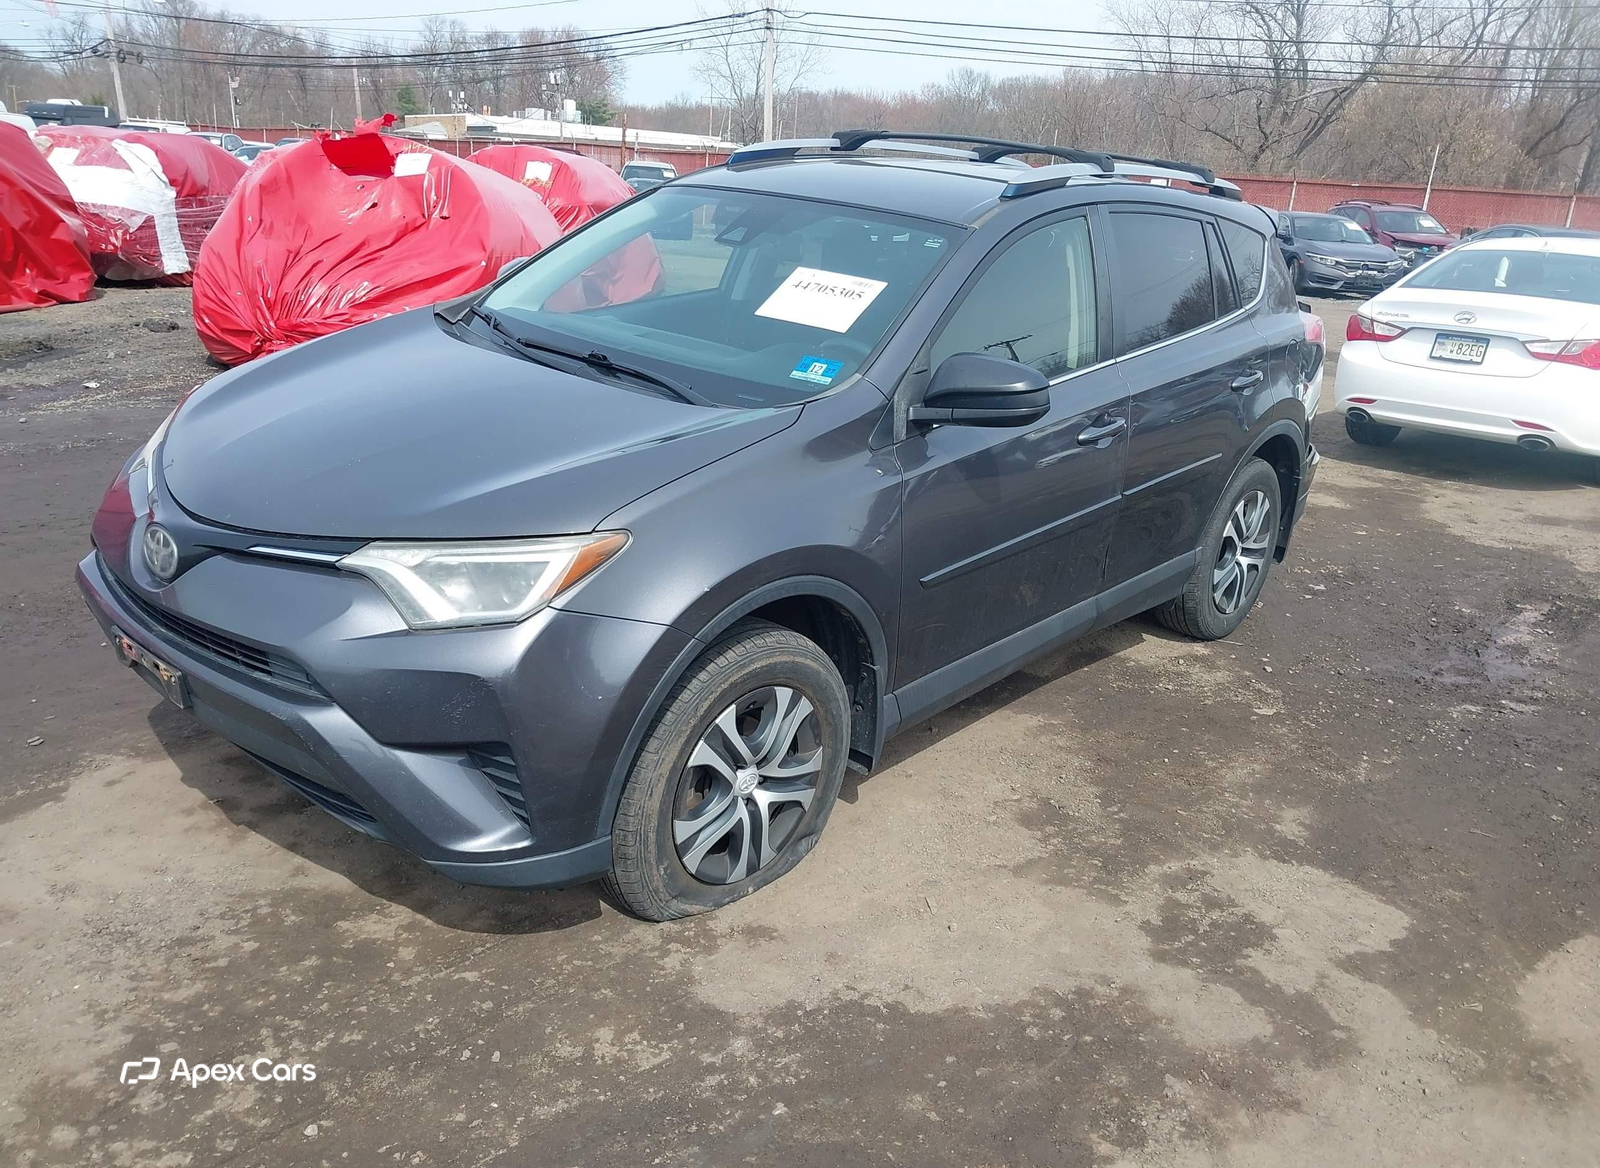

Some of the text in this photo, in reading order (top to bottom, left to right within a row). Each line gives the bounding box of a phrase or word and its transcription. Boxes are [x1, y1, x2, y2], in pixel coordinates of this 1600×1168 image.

[792, 280, 866, 301] 44705305
[1375, 311, 1410, 319] SONATA
[809, 363, 824, 375] 12
